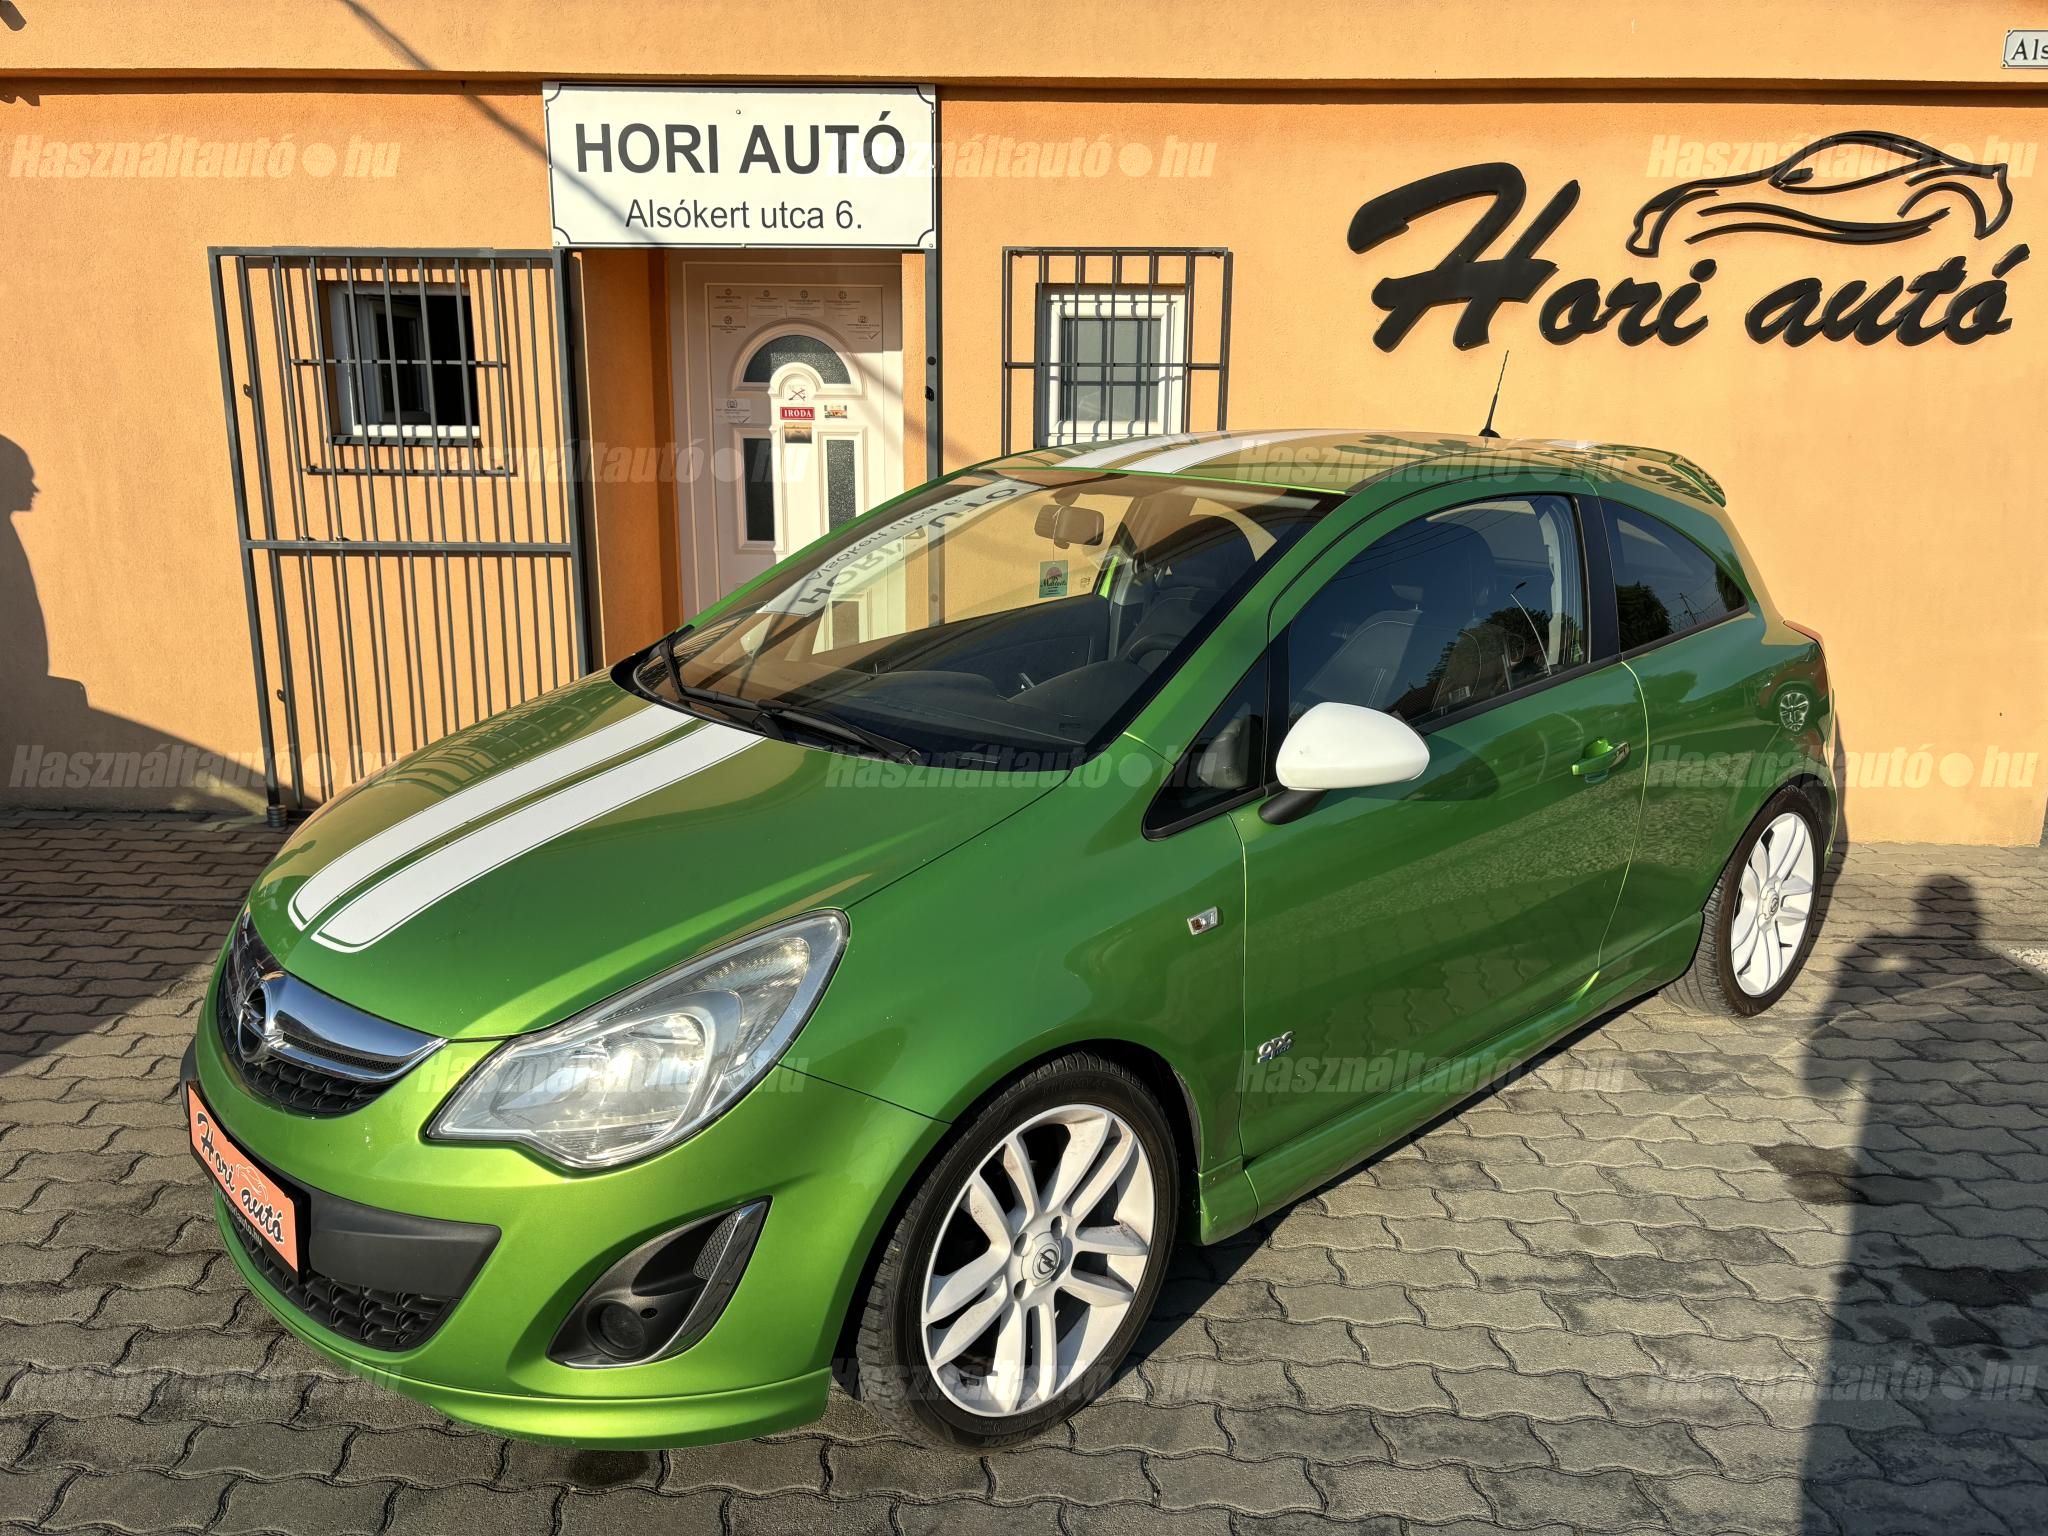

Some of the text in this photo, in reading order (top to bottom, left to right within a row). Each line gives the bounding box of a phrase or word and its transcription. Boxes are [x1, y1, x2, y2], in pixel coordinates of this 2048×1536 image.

[576, 111, 905, 174] HORI AUTÓ
[625, 199, 862, 229] Alsókert utca 6.
[1347, 162, 2030, 352] Hori autó
[784, 409, 812, 418] IRODA
[197, 1111, 285, 1244] Hori autó
